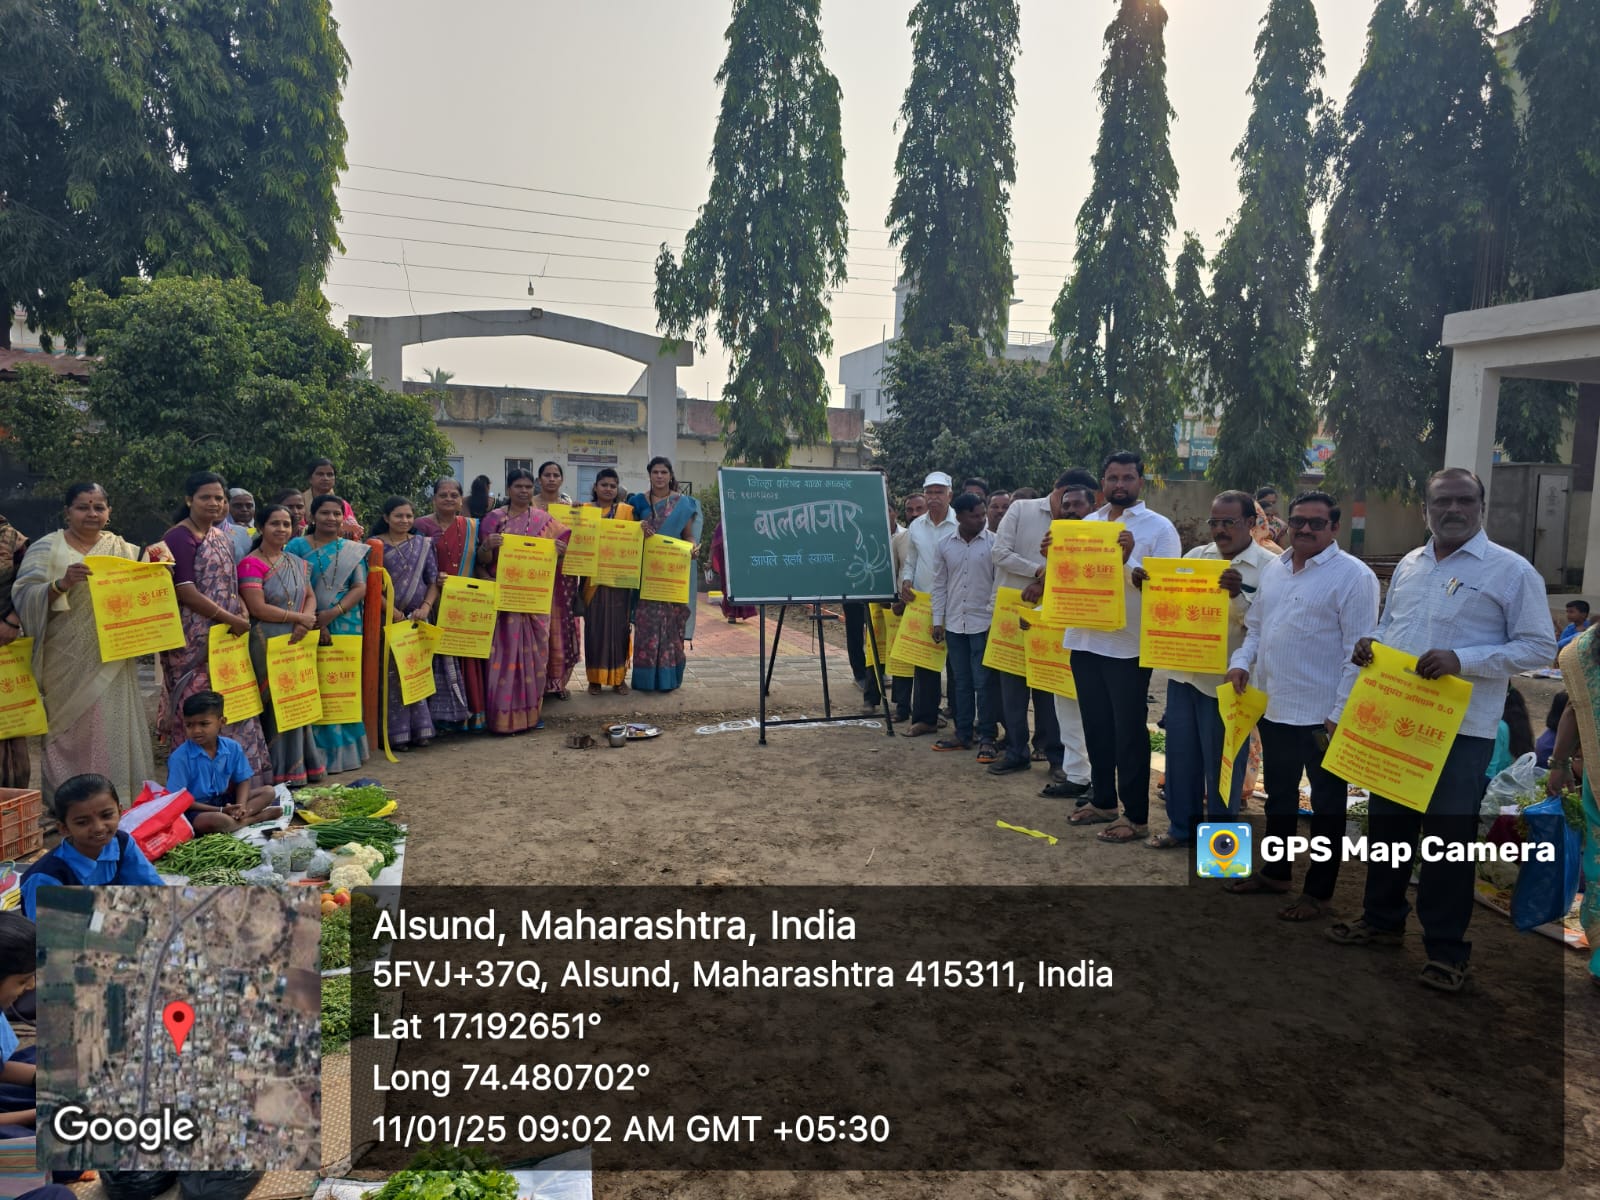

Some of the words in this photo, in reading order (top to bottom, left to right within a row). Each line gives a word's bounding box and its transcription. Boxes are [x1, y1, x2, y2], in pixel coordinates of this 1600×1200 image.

[754, 499, 863, 550] बालबाजार
[751, 549, 778, 568] आपले
[783, 548, 802, 567] सहर्ष
[1201, 606, 1223, 617] LiFE
[1417, 722, 1447, 743] LiFE
